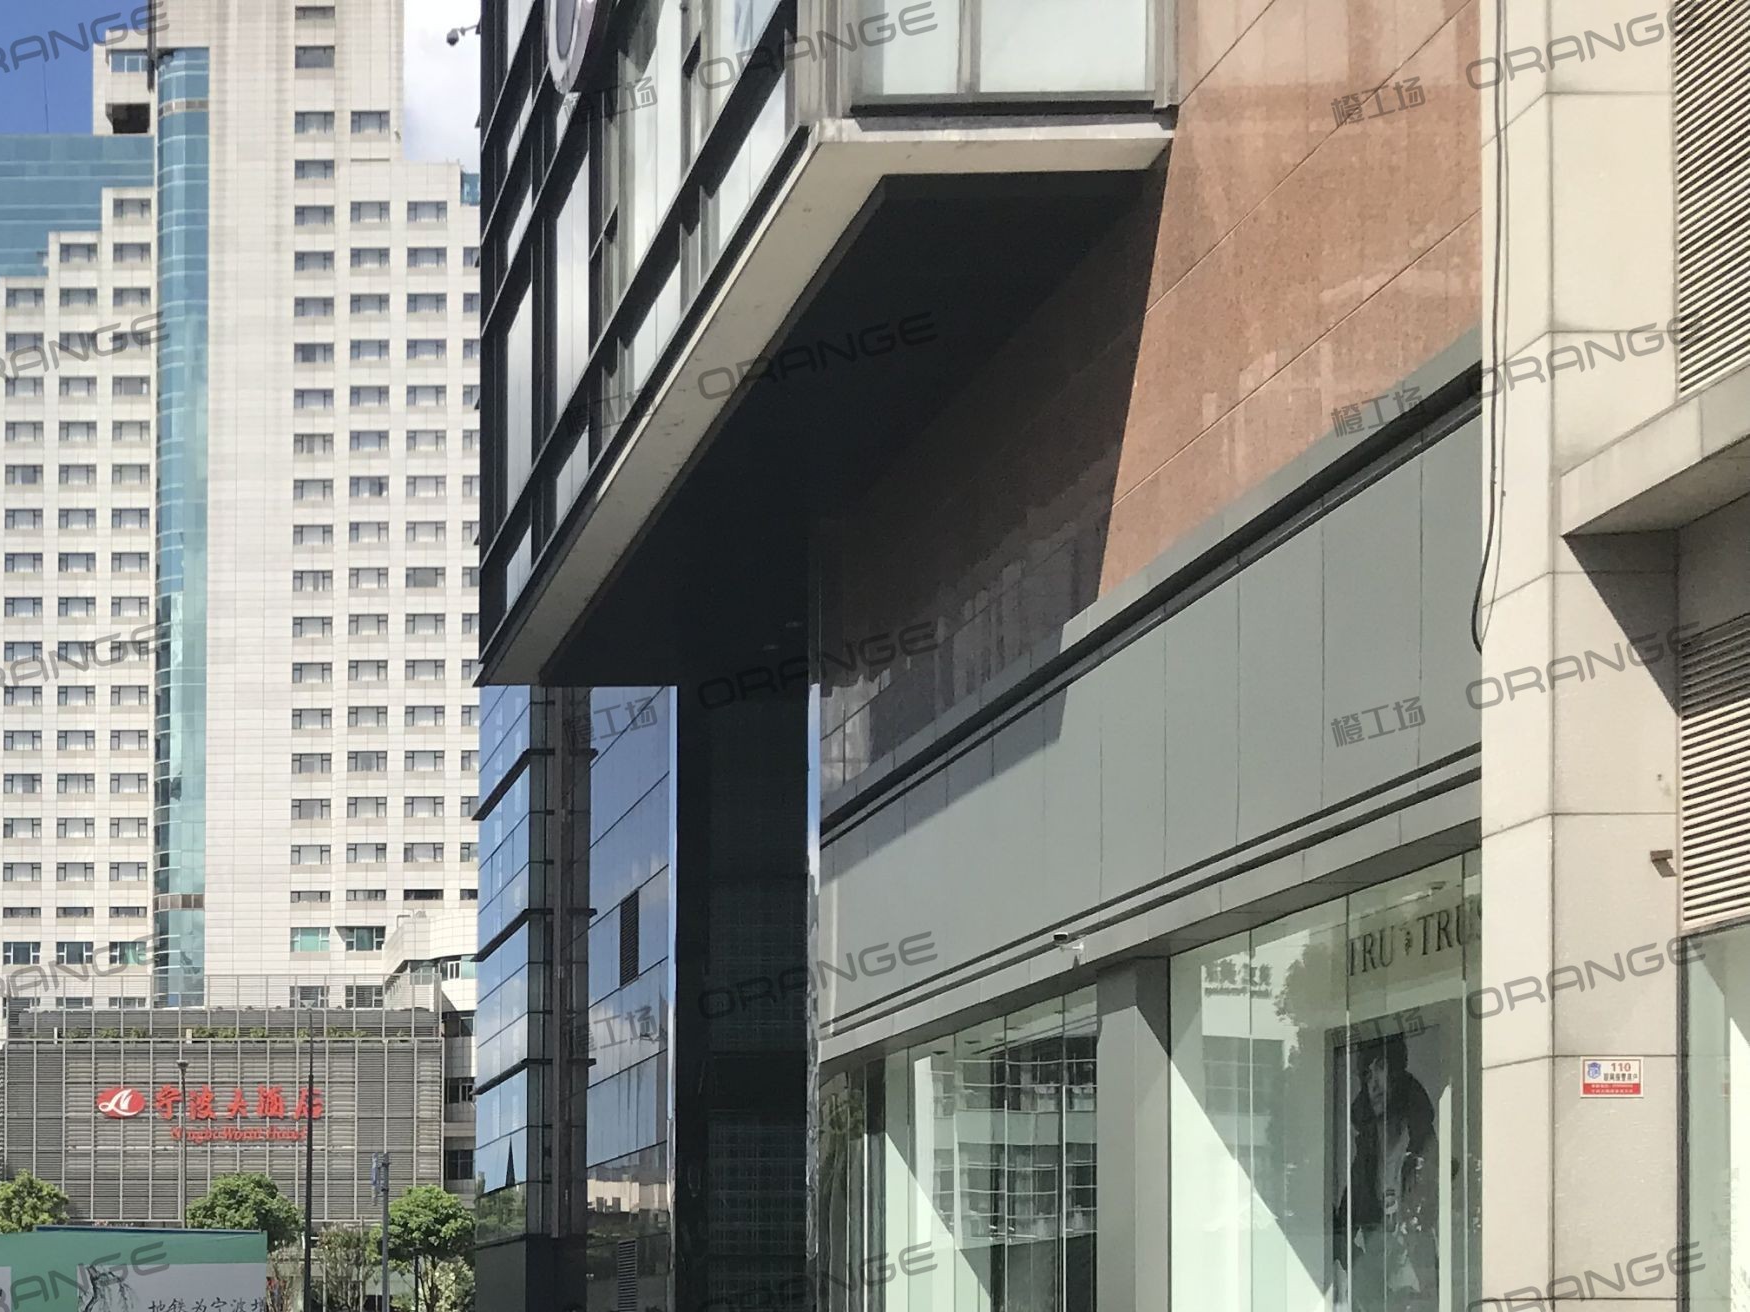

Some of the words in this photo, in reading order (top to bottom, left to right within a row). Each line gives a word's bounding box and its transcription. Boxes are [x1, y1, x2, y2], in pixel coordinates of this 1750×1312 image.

[1418, 902, 1482, 956] TRU
[1610, 1062, 1632, 1072] 110
[155, 1084, 324, 1120] 宁波大酒店
